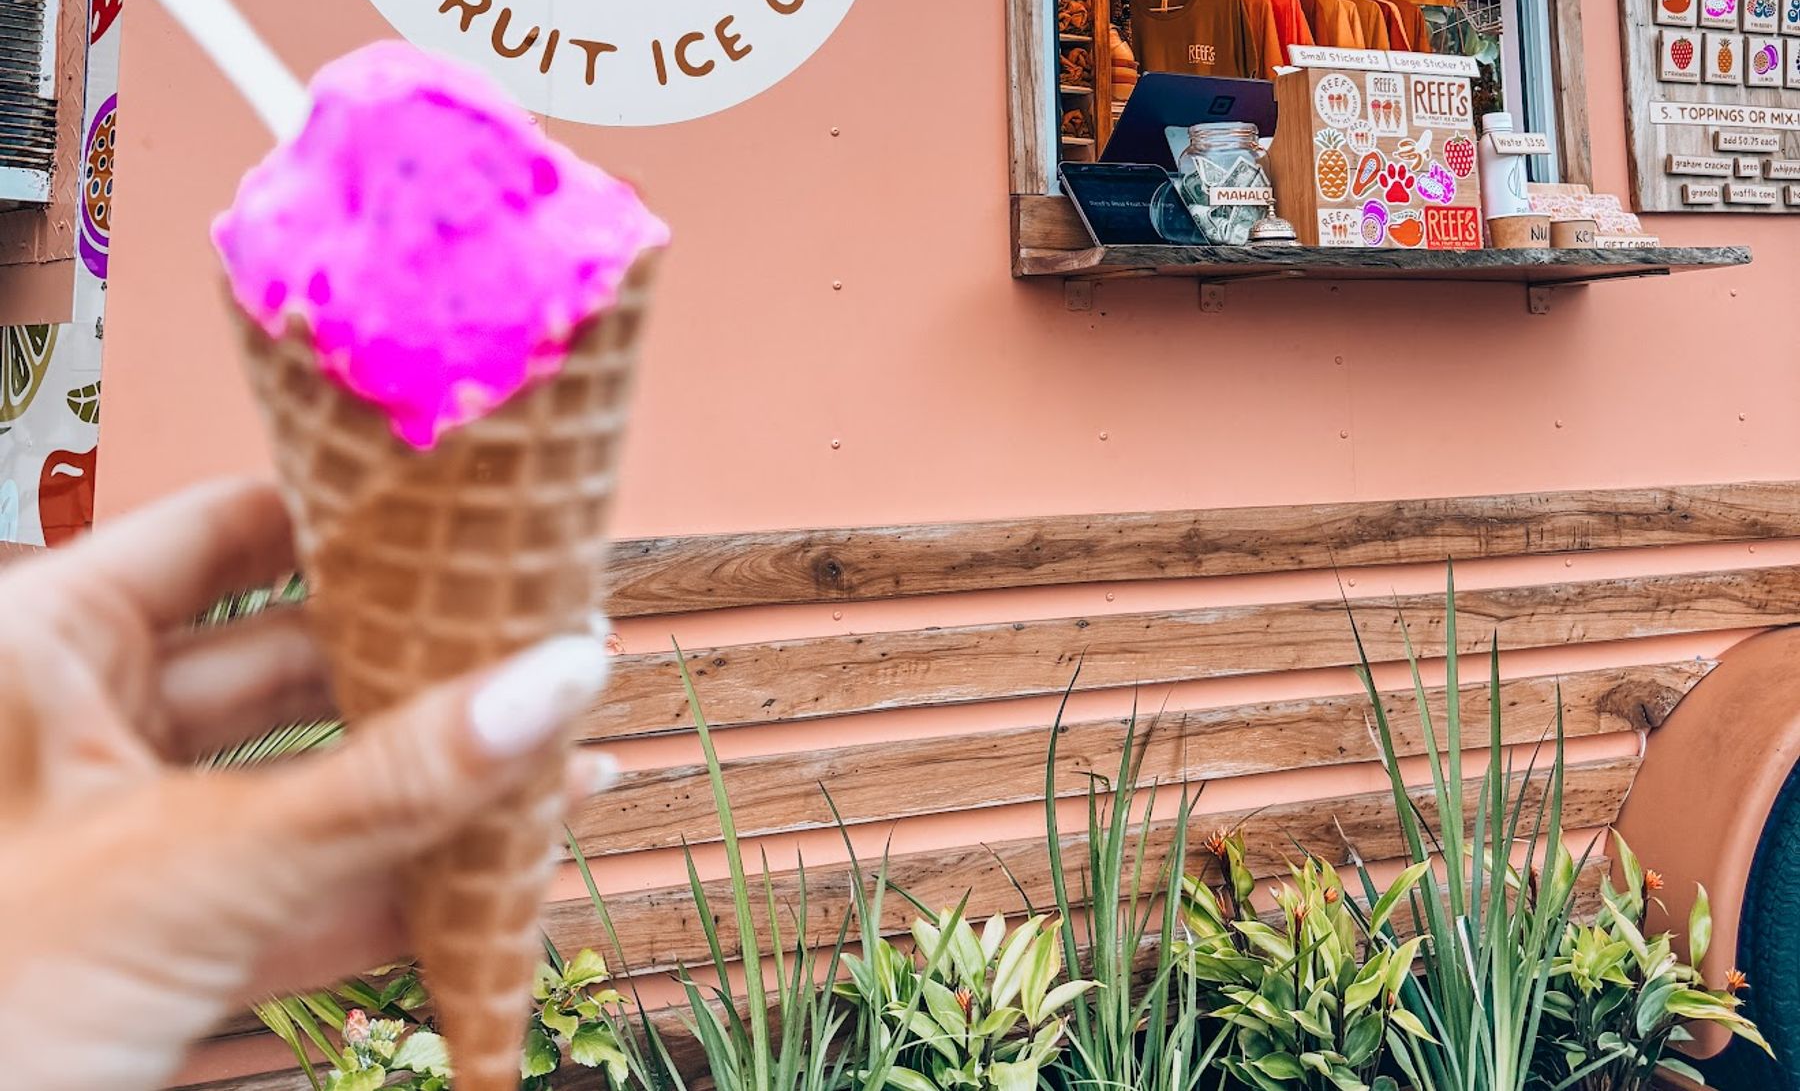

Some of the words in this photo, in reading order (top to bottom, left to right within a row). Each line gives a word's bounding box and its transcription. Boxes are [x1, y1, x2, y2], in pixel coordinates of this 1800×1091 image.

[1667, 14, 1688, 22] MANGO
[651, 14, 753, 86] ICE
[1299, 50, 1327, 61] Small
[1329, 53, 1365, 64] Sticker
[1394, 57, 1421, 69] Large
[1423, 59, 1457, 70] Sticker
[1679, 107, 1744, 123] TOPPINGS
[1749, 110, 1766, 123] OR
[1497, 137, 1521, 147] Water
[1723, 136, 1737, 145] add
[1760, 138, 1778, 146] each
[1674, 159, 1702, 169] graham
[1704, 160, 1732, 169] cracker
[1217, 190, 1270, 200] MAHALO
[1691, 189, 1718, 199] granola
[1732, 188, 1757, 197] waffle
[1759, 191, 1775, 199] cone
